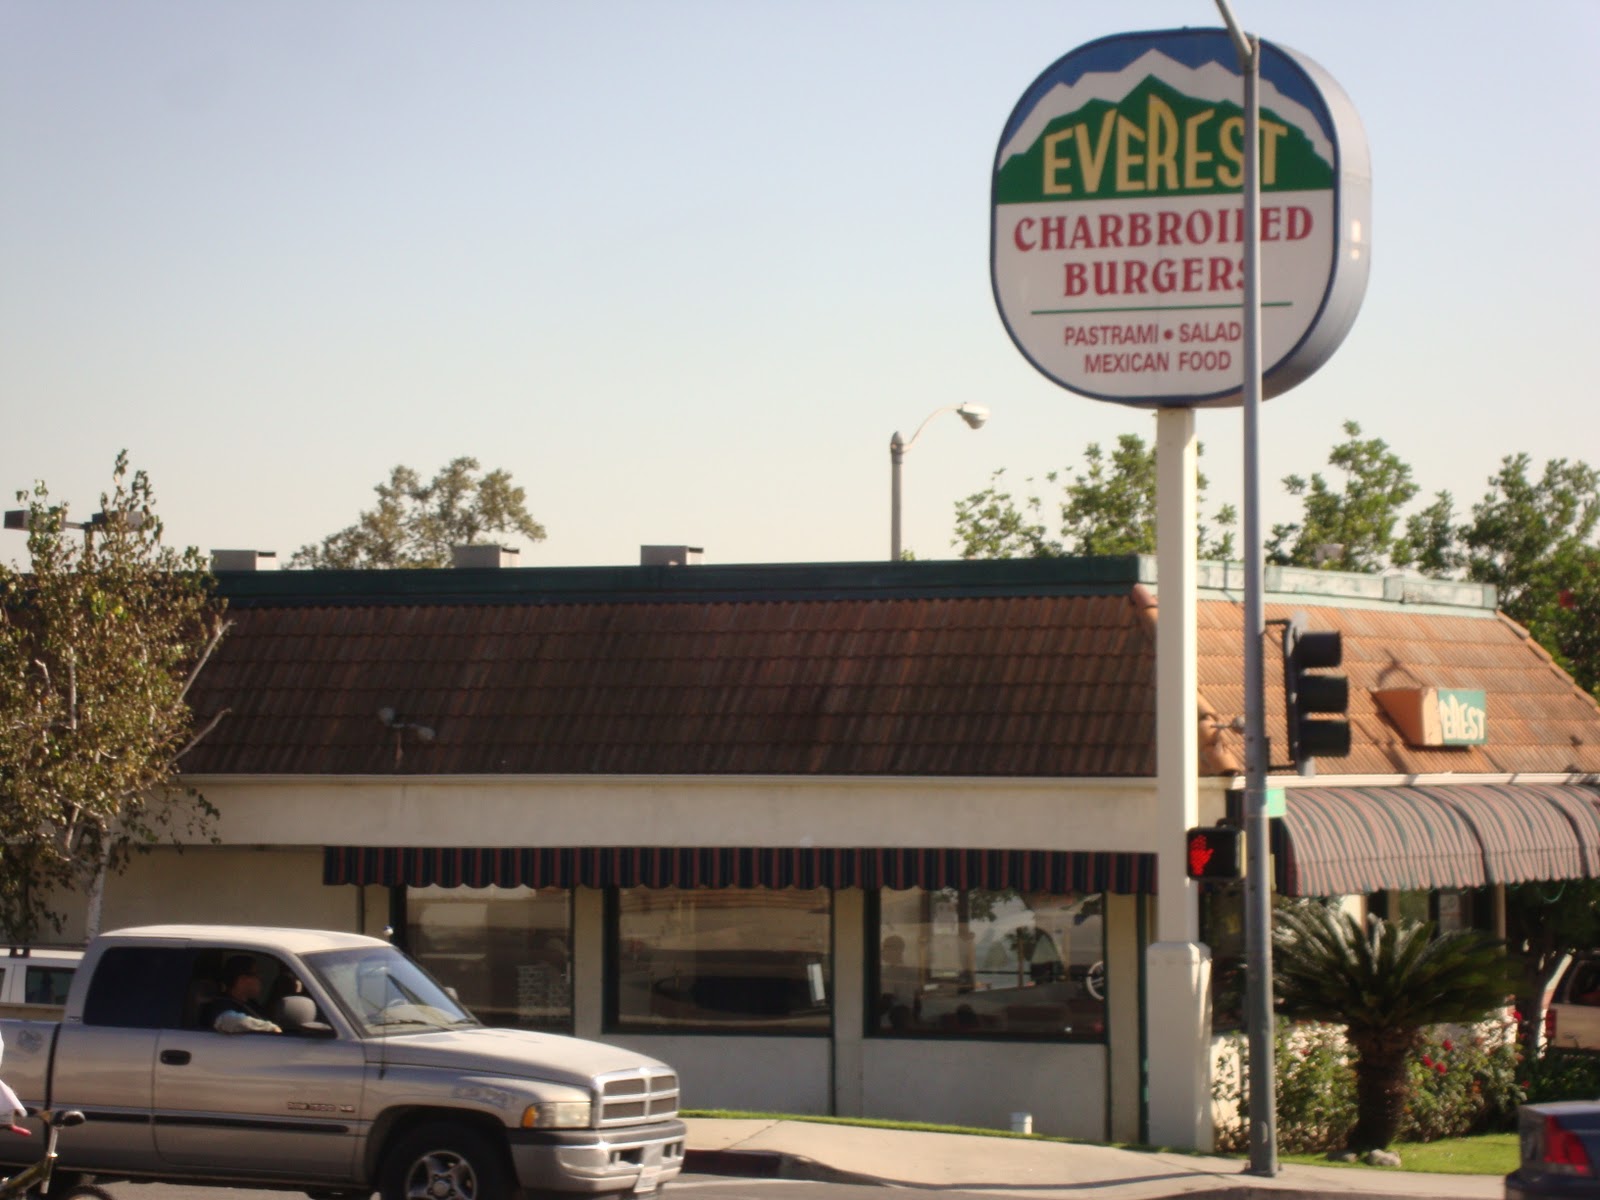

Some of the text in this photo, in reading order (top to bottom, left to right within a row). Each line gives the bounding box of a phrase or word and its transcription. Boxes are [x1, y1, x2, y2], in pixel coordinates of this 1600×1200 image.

[1043, 94, 1288, 195] EVEREST
[1064, 323, 1159, 346] PASTRAMI
[1084, 350, 1232, 374] MEXICAN FOOD
